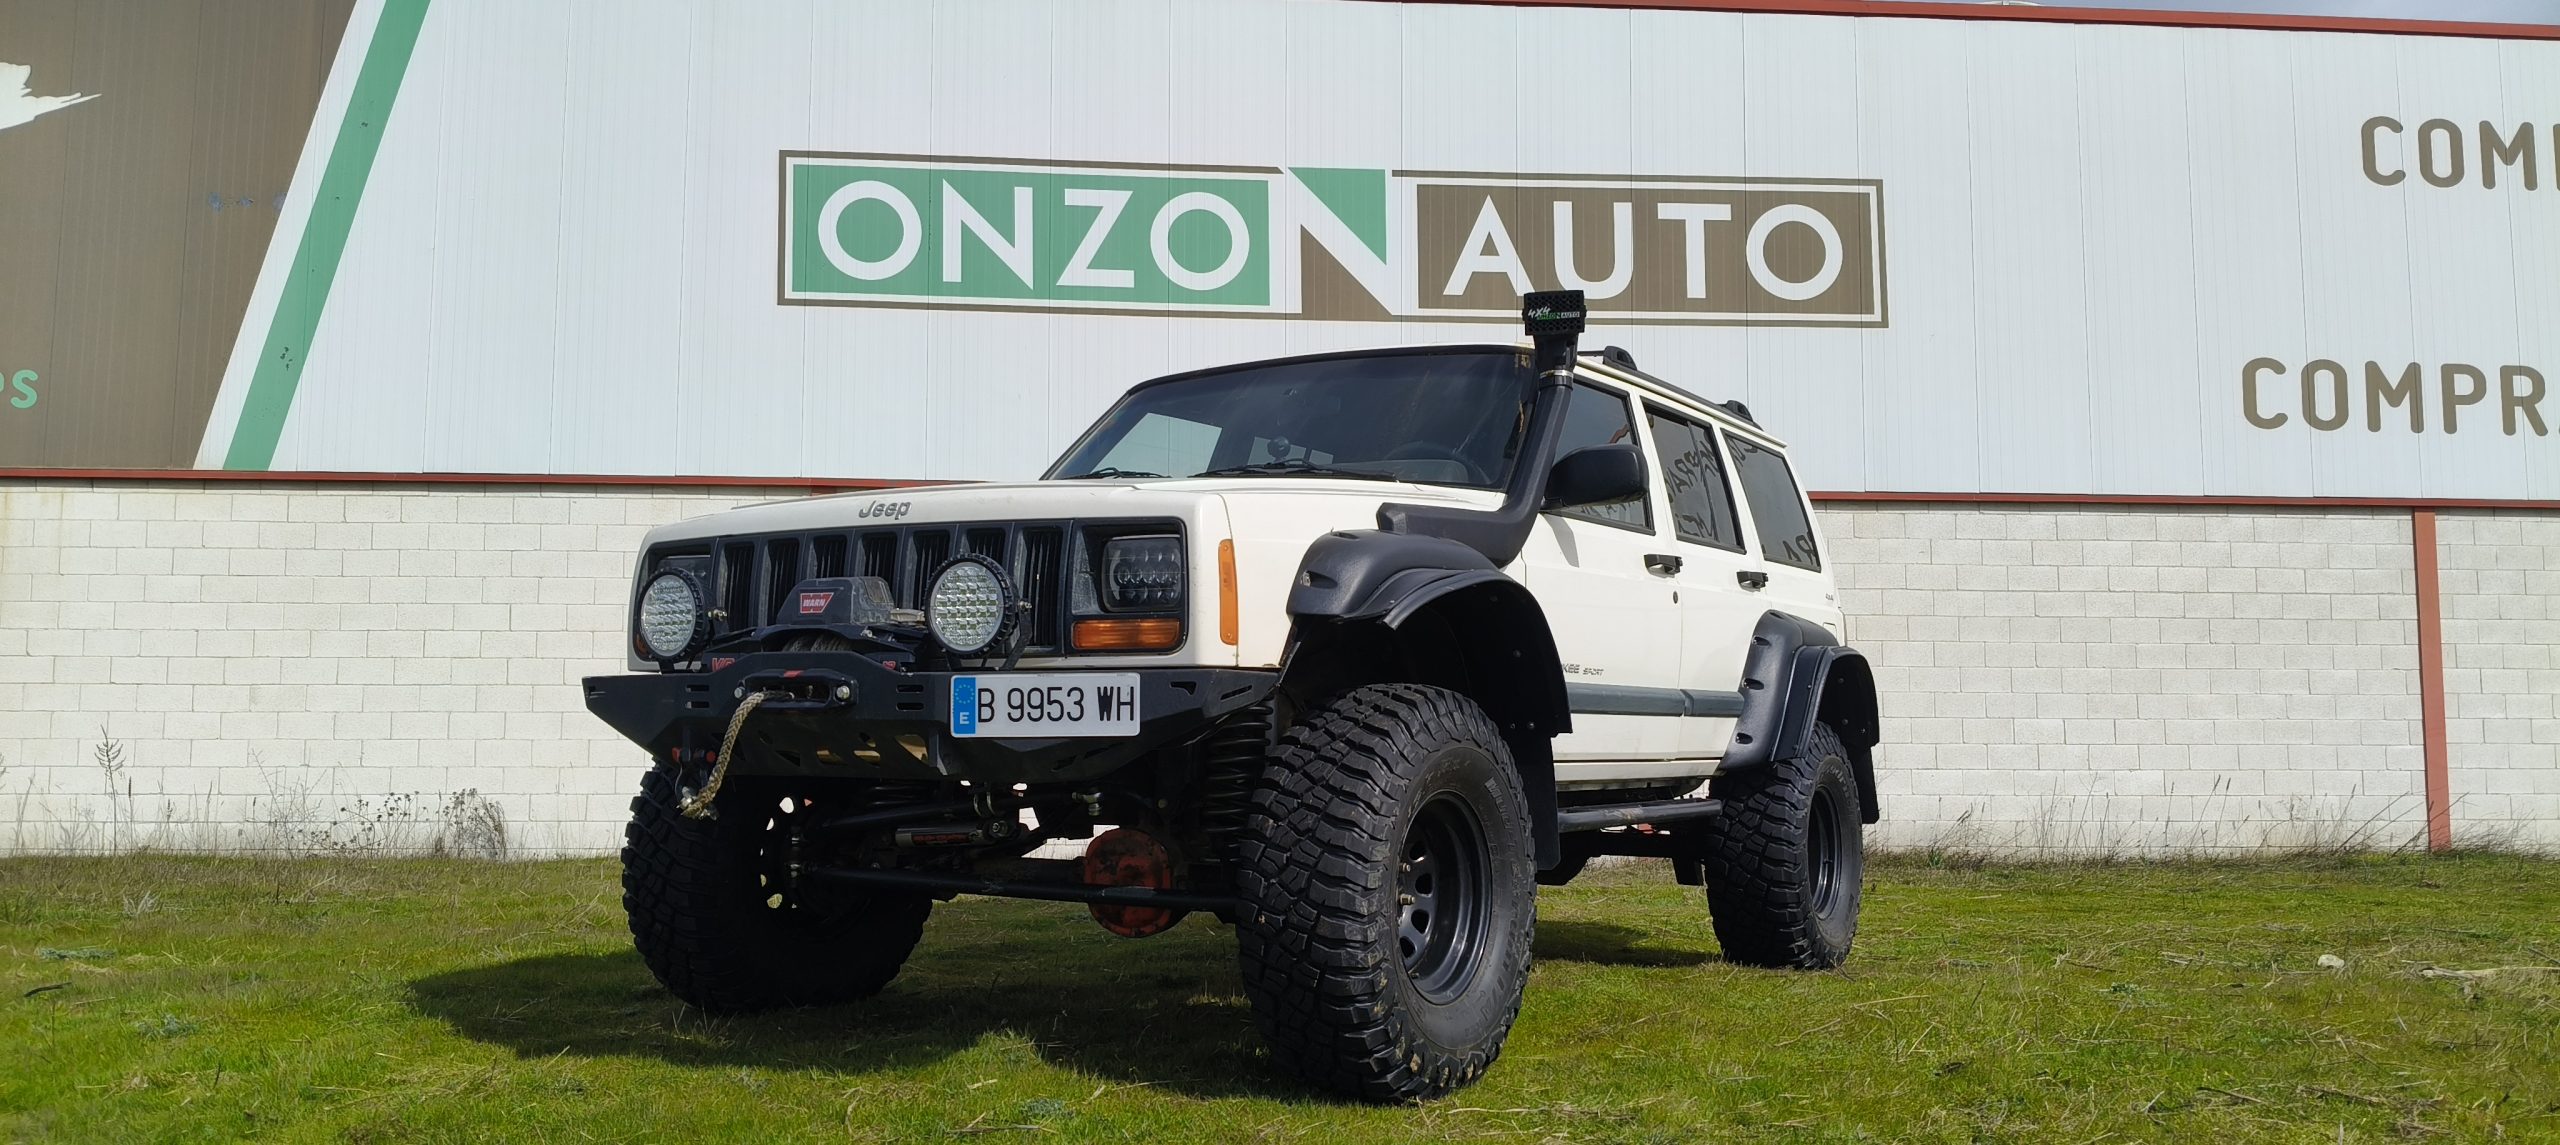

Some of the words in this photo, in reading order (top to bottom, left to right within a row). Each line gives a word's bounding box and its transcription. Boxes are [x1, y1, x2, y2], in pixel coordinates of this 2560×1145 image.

[2361, 116, 2560, 191] COM
[1443, 195, 1843, 301] AUTO
[2242, 357, 2560, 436] COMPR
[858, 500, 911, 520] Jeep
[803, 599, 826, 607] WARN
[959, 712, 970, 725] E
[977, 688, 995, 723] B
[1007, 687, 1085, 723] 9953
[1097, 686, 1134, 721] WH
